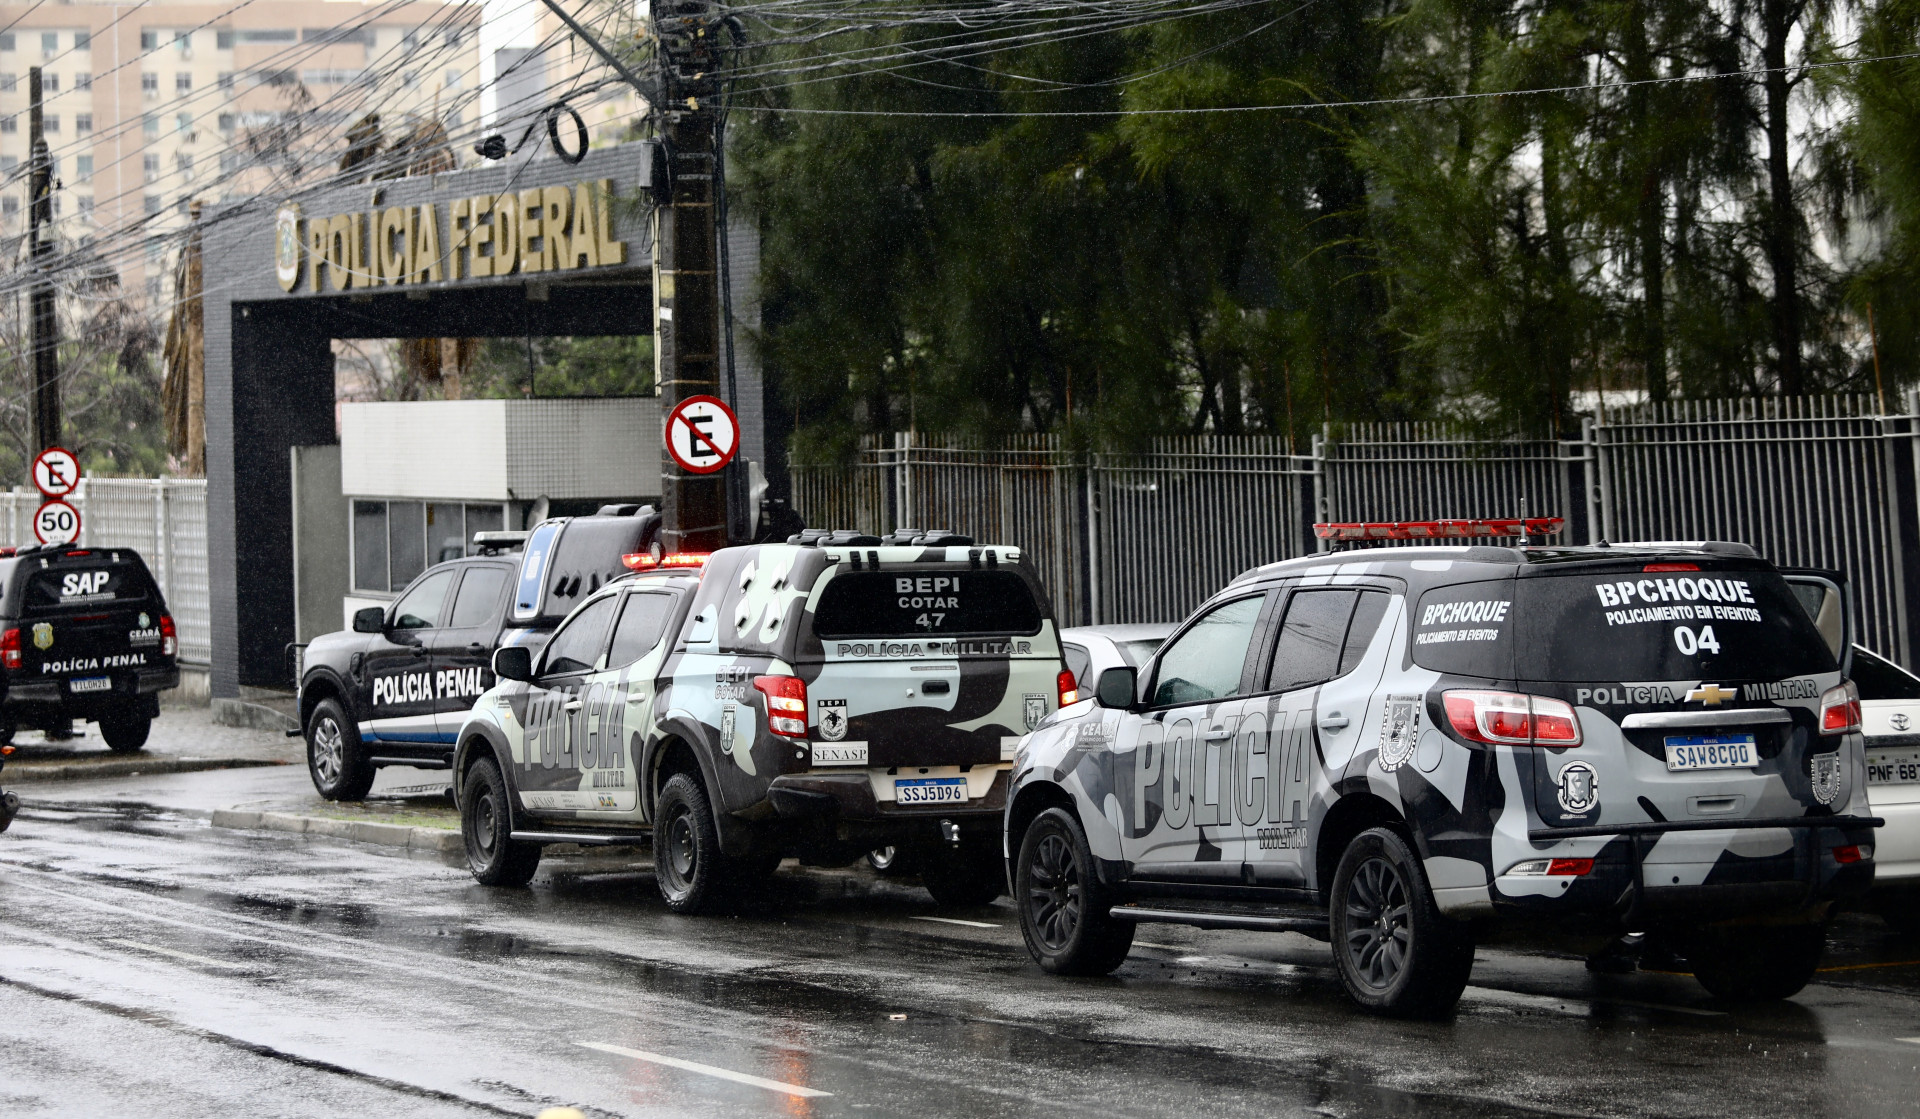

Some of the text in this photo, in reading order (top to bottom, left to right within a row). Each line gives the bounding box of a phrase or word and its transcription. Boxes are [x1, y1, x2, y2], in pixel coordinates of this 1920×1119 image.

[309, 178, 627, 293] POLÍCIA FEDERAL
[689, 415, 716, 458] E
[48, 462, 66, 486] E
[42, 511, 73, 531] 50
[62, 571, 110, 596] SAP
[896, 577, 960, 593] BEPI
[1596, 578, 1756, 607] BPCHOQUE
[898, 597, 959, 609] COTAR
[1422, 600, 1511, 626] BPCHOQUE
[916, 613, 946, 627] 47
[1606, 606, 1762, 626] POLICIAMENTO EM EVENTOS
[129, 626, 160, 638] CEARÁ
[1416, 629, 1498, 645] POLICIAMENTO EM EVENTOS
[1674, 625, 1720, 656] 04
[838, 641, 1032, 657] POLÍCIA MILITAR
[42, 653, 147, 674] POLÍCIA PENAL
[716, 664, 752, 683] BEPI
[373, 666, 484, 706] POLÍCIA PENAL
[714, 684, 745, 700] COTAR
[1743, 680, 1819, 701] MILITAR
[814, 749, 867, 760] SENASP
[1676, 745, 1748, 766] SAW8C00
[592, 770, 624, 788] MILITAR
[904, 786, 960, 801] SSJ5D96
[1258, 828, 1308, 850] MILITAR
